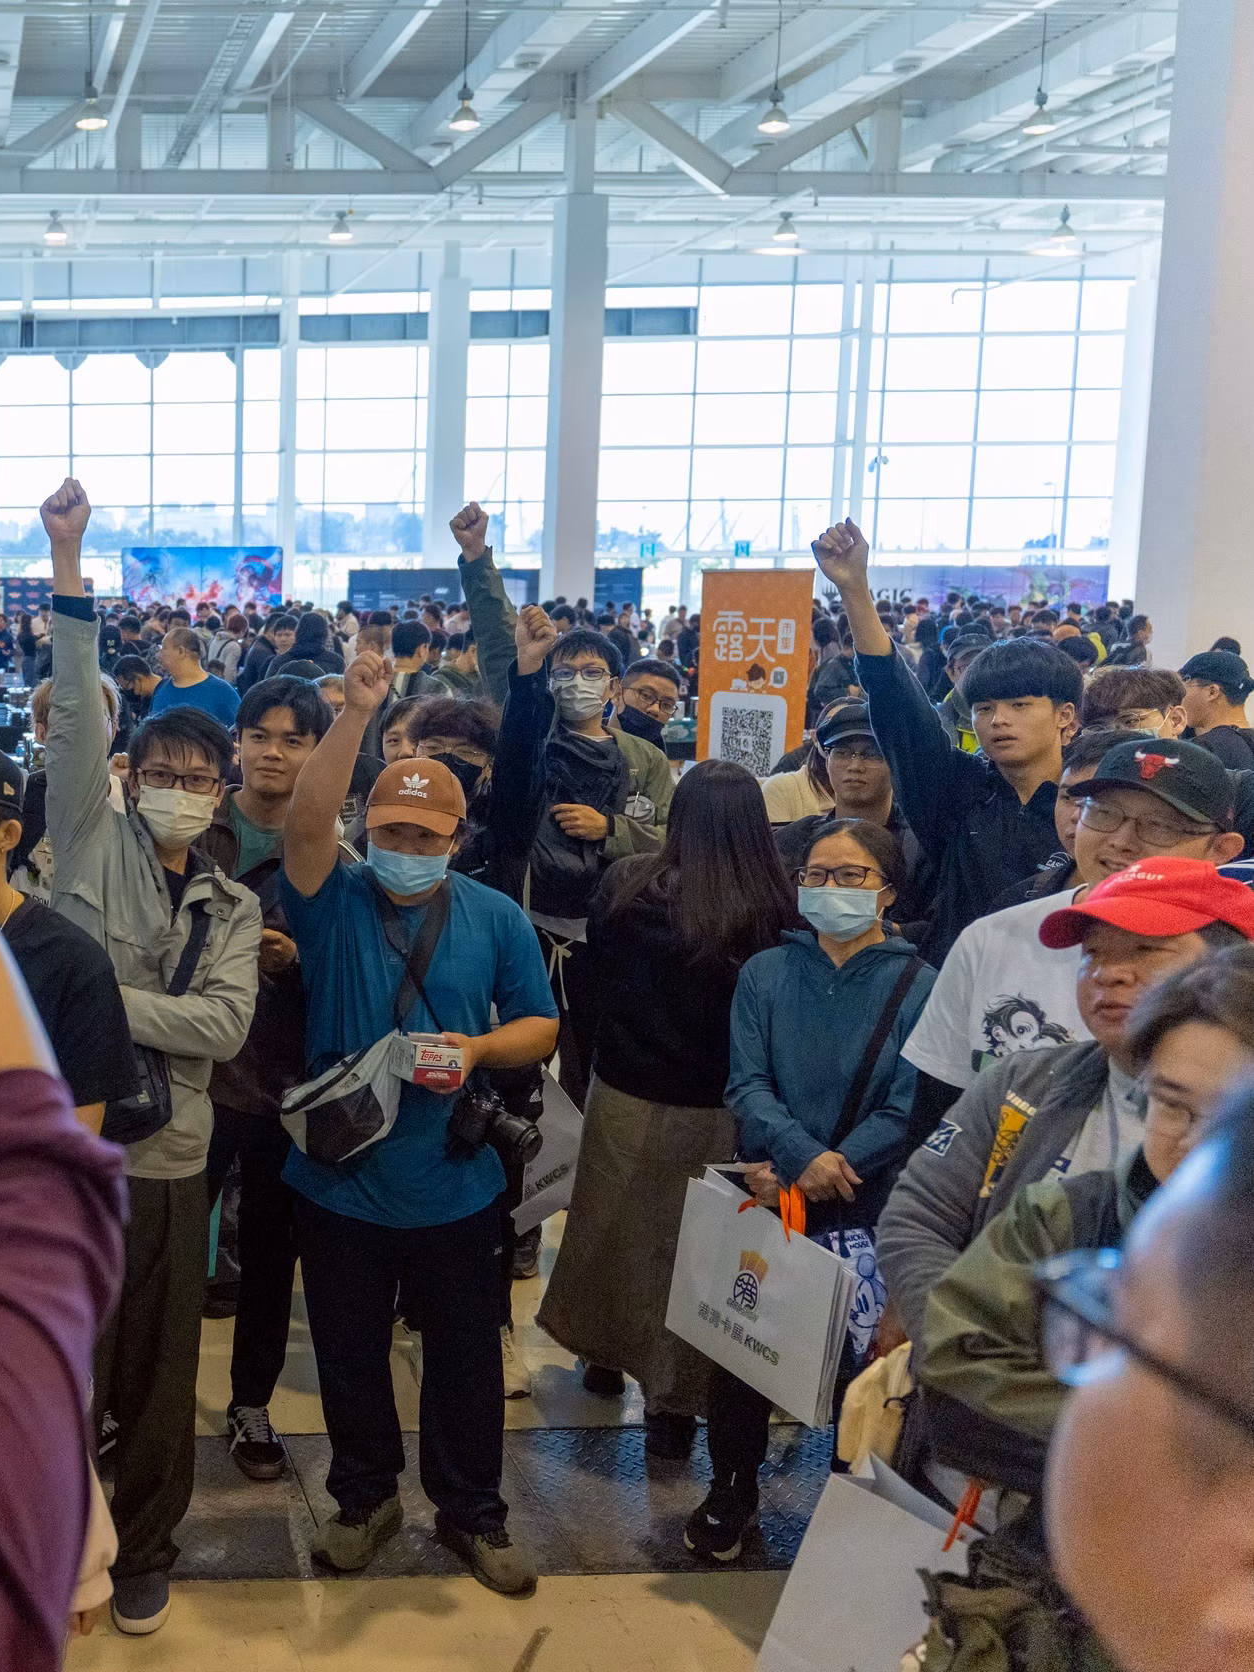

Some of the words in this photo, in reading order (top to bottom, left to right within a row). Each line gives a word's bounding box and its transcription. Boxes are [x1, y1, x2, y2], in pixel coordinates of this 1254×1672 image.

[712, 610, 777, 663] 露天
[398, 788, 428, 799] adidas
[535, 1163, 569, 1191] KWCS
[744, 1334, 780, 1366] KWCS
